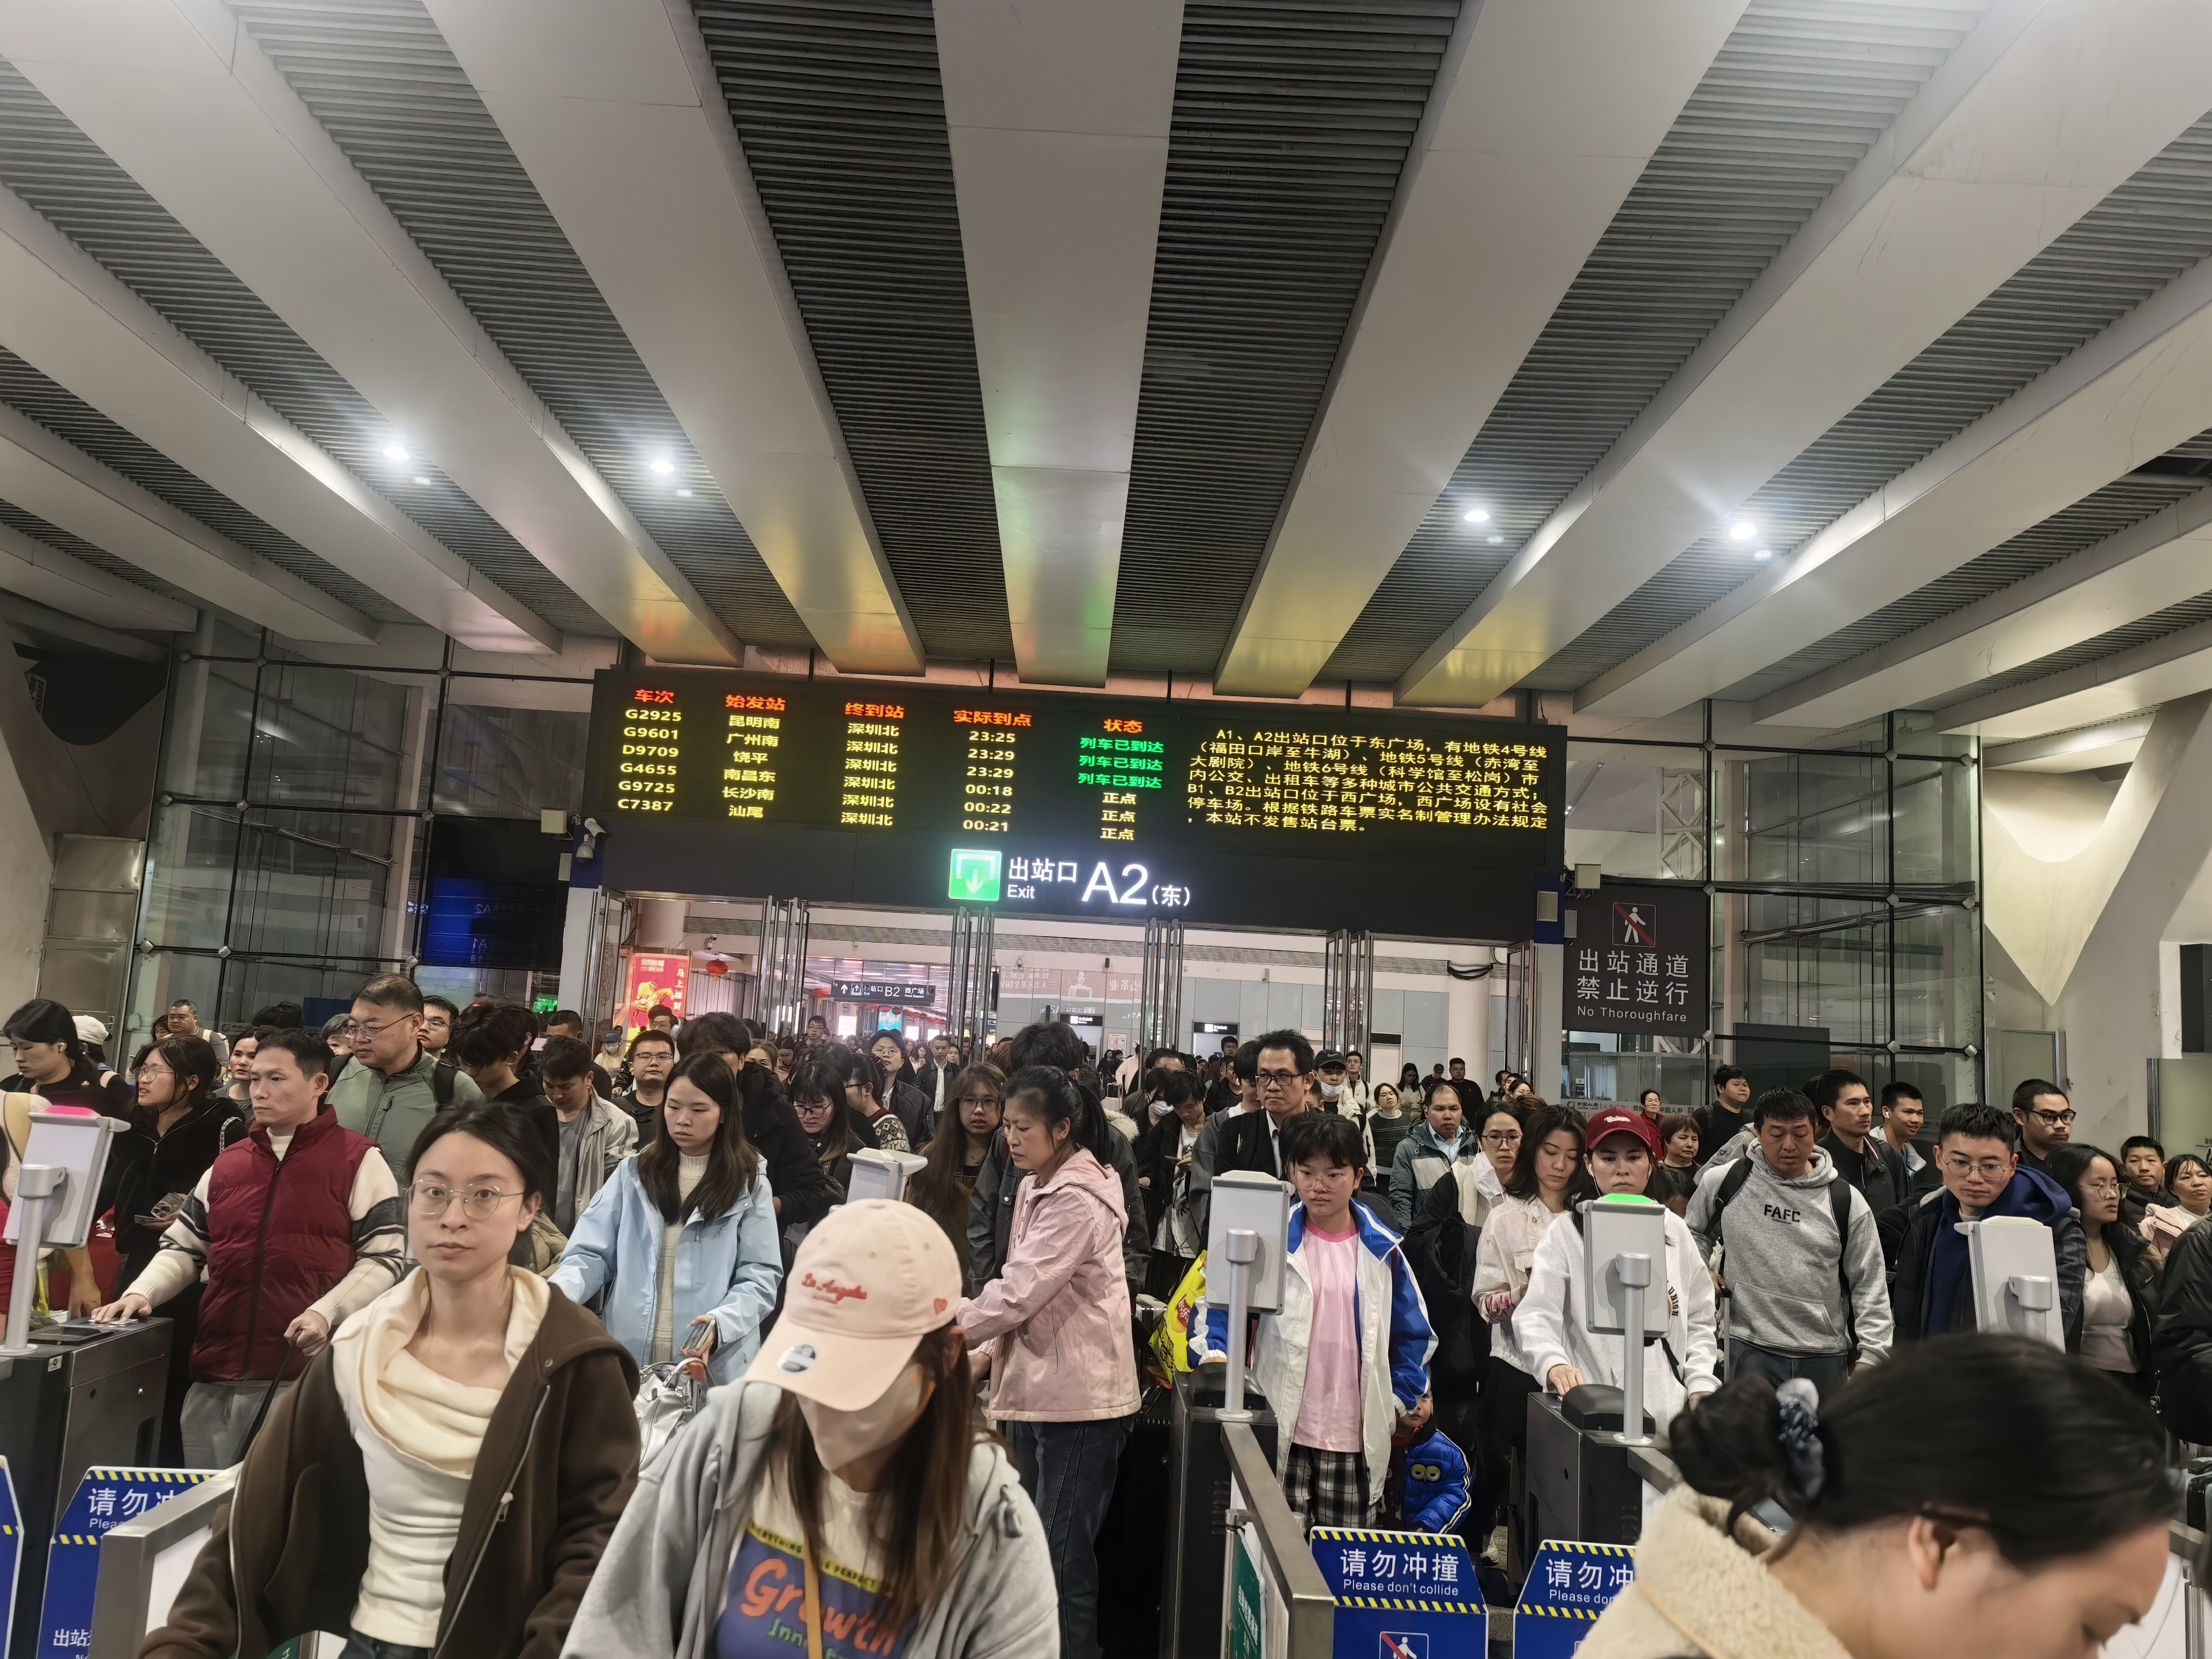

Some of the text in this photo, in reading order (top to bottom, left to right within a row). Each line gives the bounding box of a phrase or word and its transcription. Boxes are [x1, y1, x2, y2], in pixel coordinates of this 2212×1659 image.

[635, 690, 1142, 733] 车次 始发站 终到站 实际到点 状态
[626, 710, 1163, 752] G2925 昆明南 深圳北 23:25 列车已到达
[624, 727, 1163, 770] G9601 广州南 深圳北 23:29 列车已到达
[623, 745, 1162, 788] D9709 饶平 深圳北 23:29 列车已到达
[621, 763, 1136, 804] G4655 南昌东 深圳北 00:18 正点
[619, 781, 1135, 822] G9725 长沙南 深圳北 00:22 正点
[618, 799, 1134, 840] C7387 汕尾 深圳北 00:21 正点
[1007, 885, 1035, 899] Exit
[1009, 857, 1077, 882] 出站口
[1081, 862, 1149, 905] A2
[1579, 948, 1689, 978] 出站通道
[885, 986, 900, 997] B2
[1576, 975, 1689, 1006] 禁止逆行
[1577, 1006, 1687, 1022] No Thoroughfare
[1764, 1204, 1801, 1223] FAFC
[1340, 1548, 1459, 1583] 请勿冲撞
[1546, 1558, 1634, 1590] 请勿冲
[1344, 1579, 1459, 1596] Please don't collide
[1549, 1589, 1590, 1602] Please
